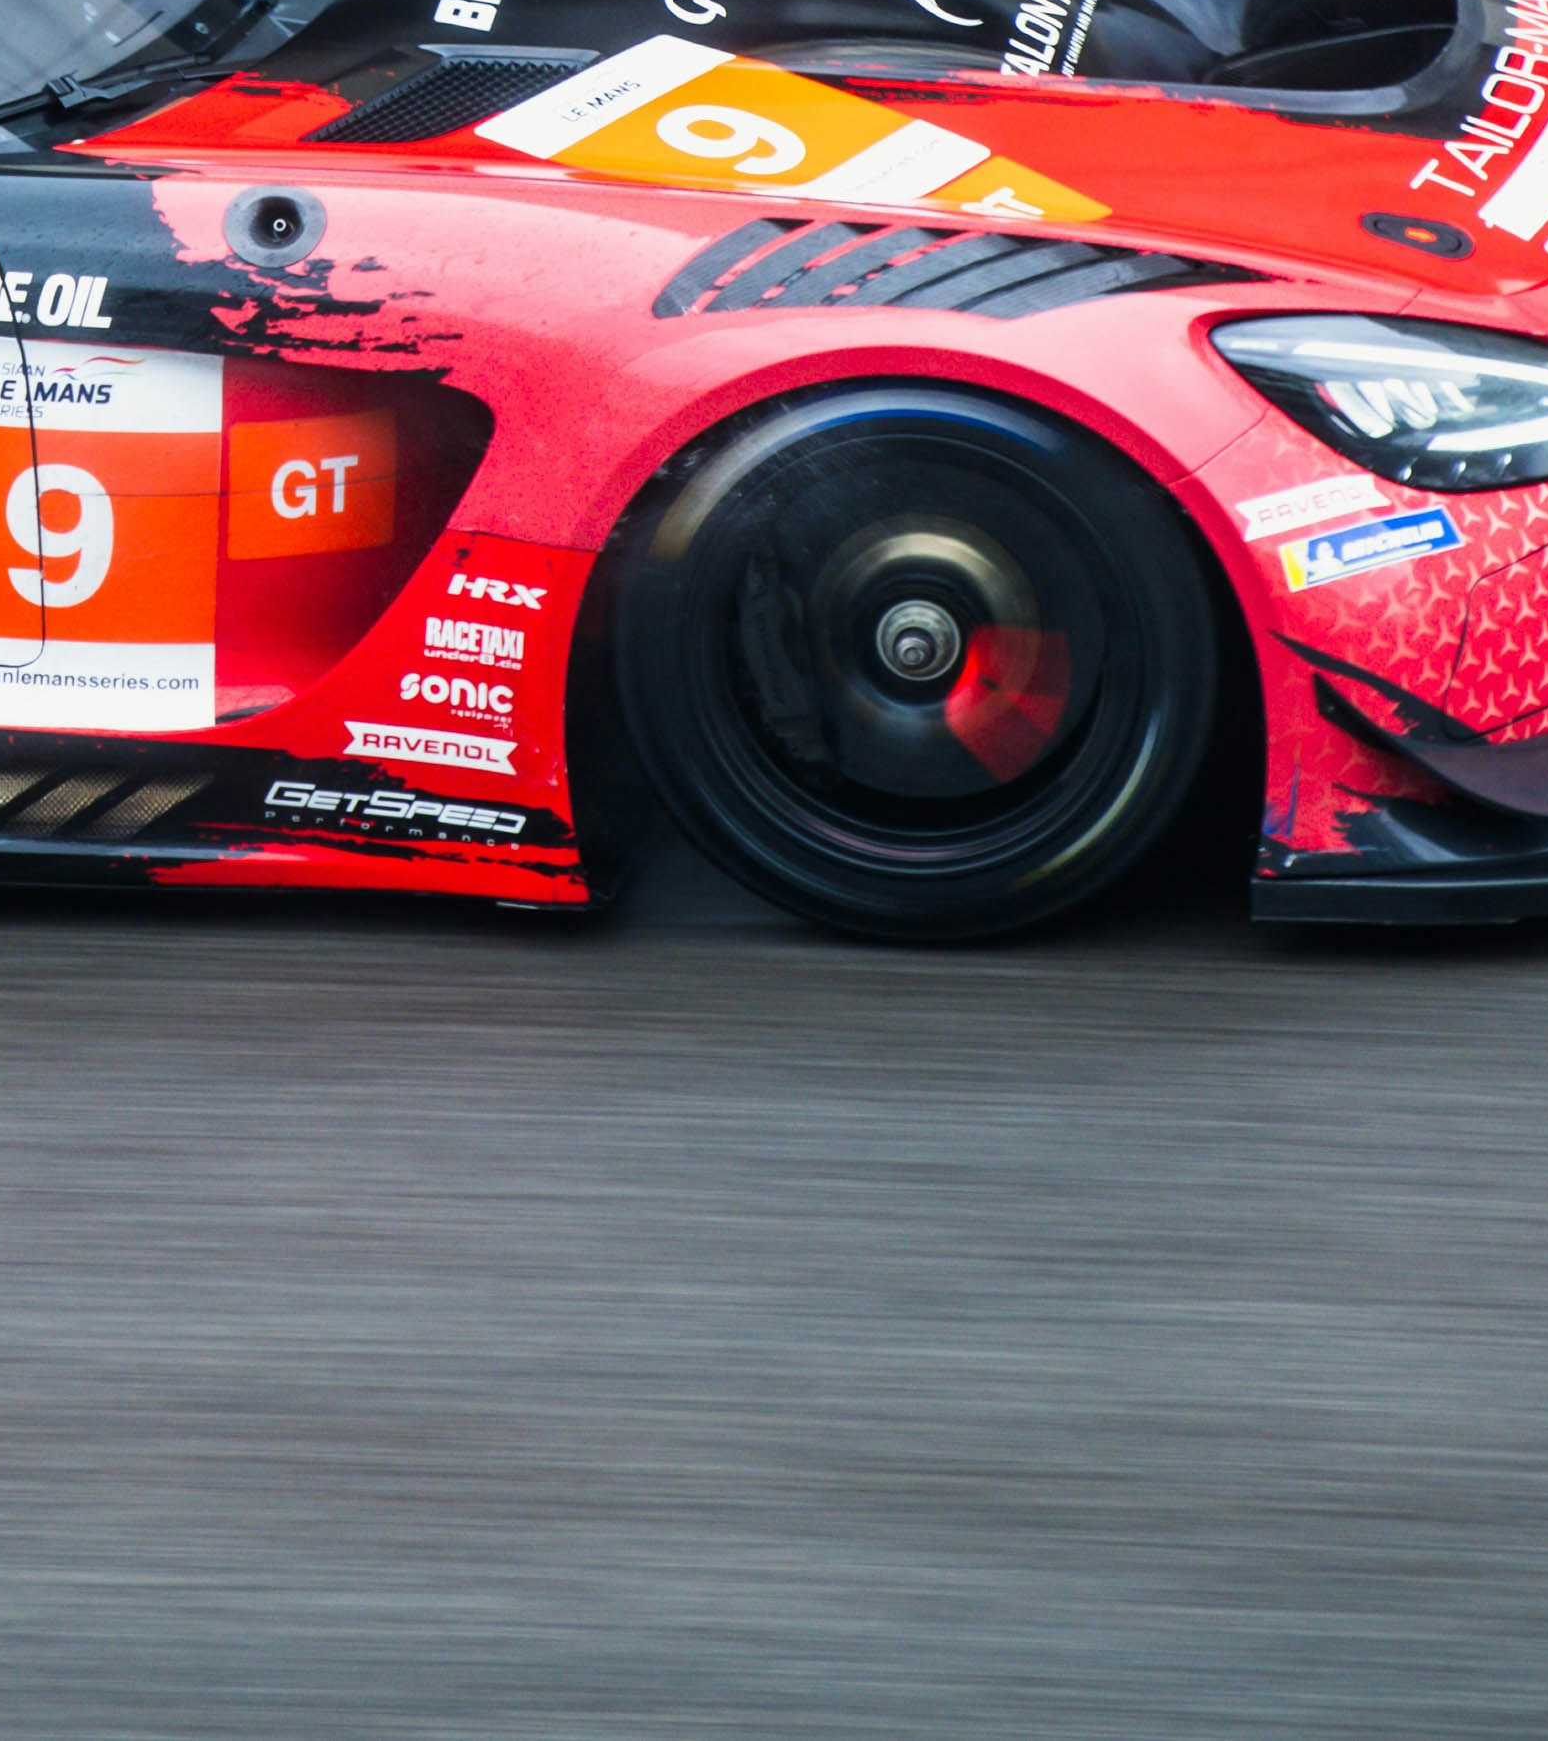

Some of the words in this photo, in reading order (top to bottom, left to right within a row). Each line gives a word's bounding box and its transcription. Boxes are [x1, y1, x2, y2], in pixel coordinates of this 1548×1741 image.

[655, 103, 807, 175] 9
[36, 273, 113, 330] OIL
[33, 380, 113, 405] MANS
[270, 454, 359, 520] GT
[5, 463, 115, 608] 9
[447, 573, 548, 611] HRX
[362, 732, 501, 764] RAVENOL
